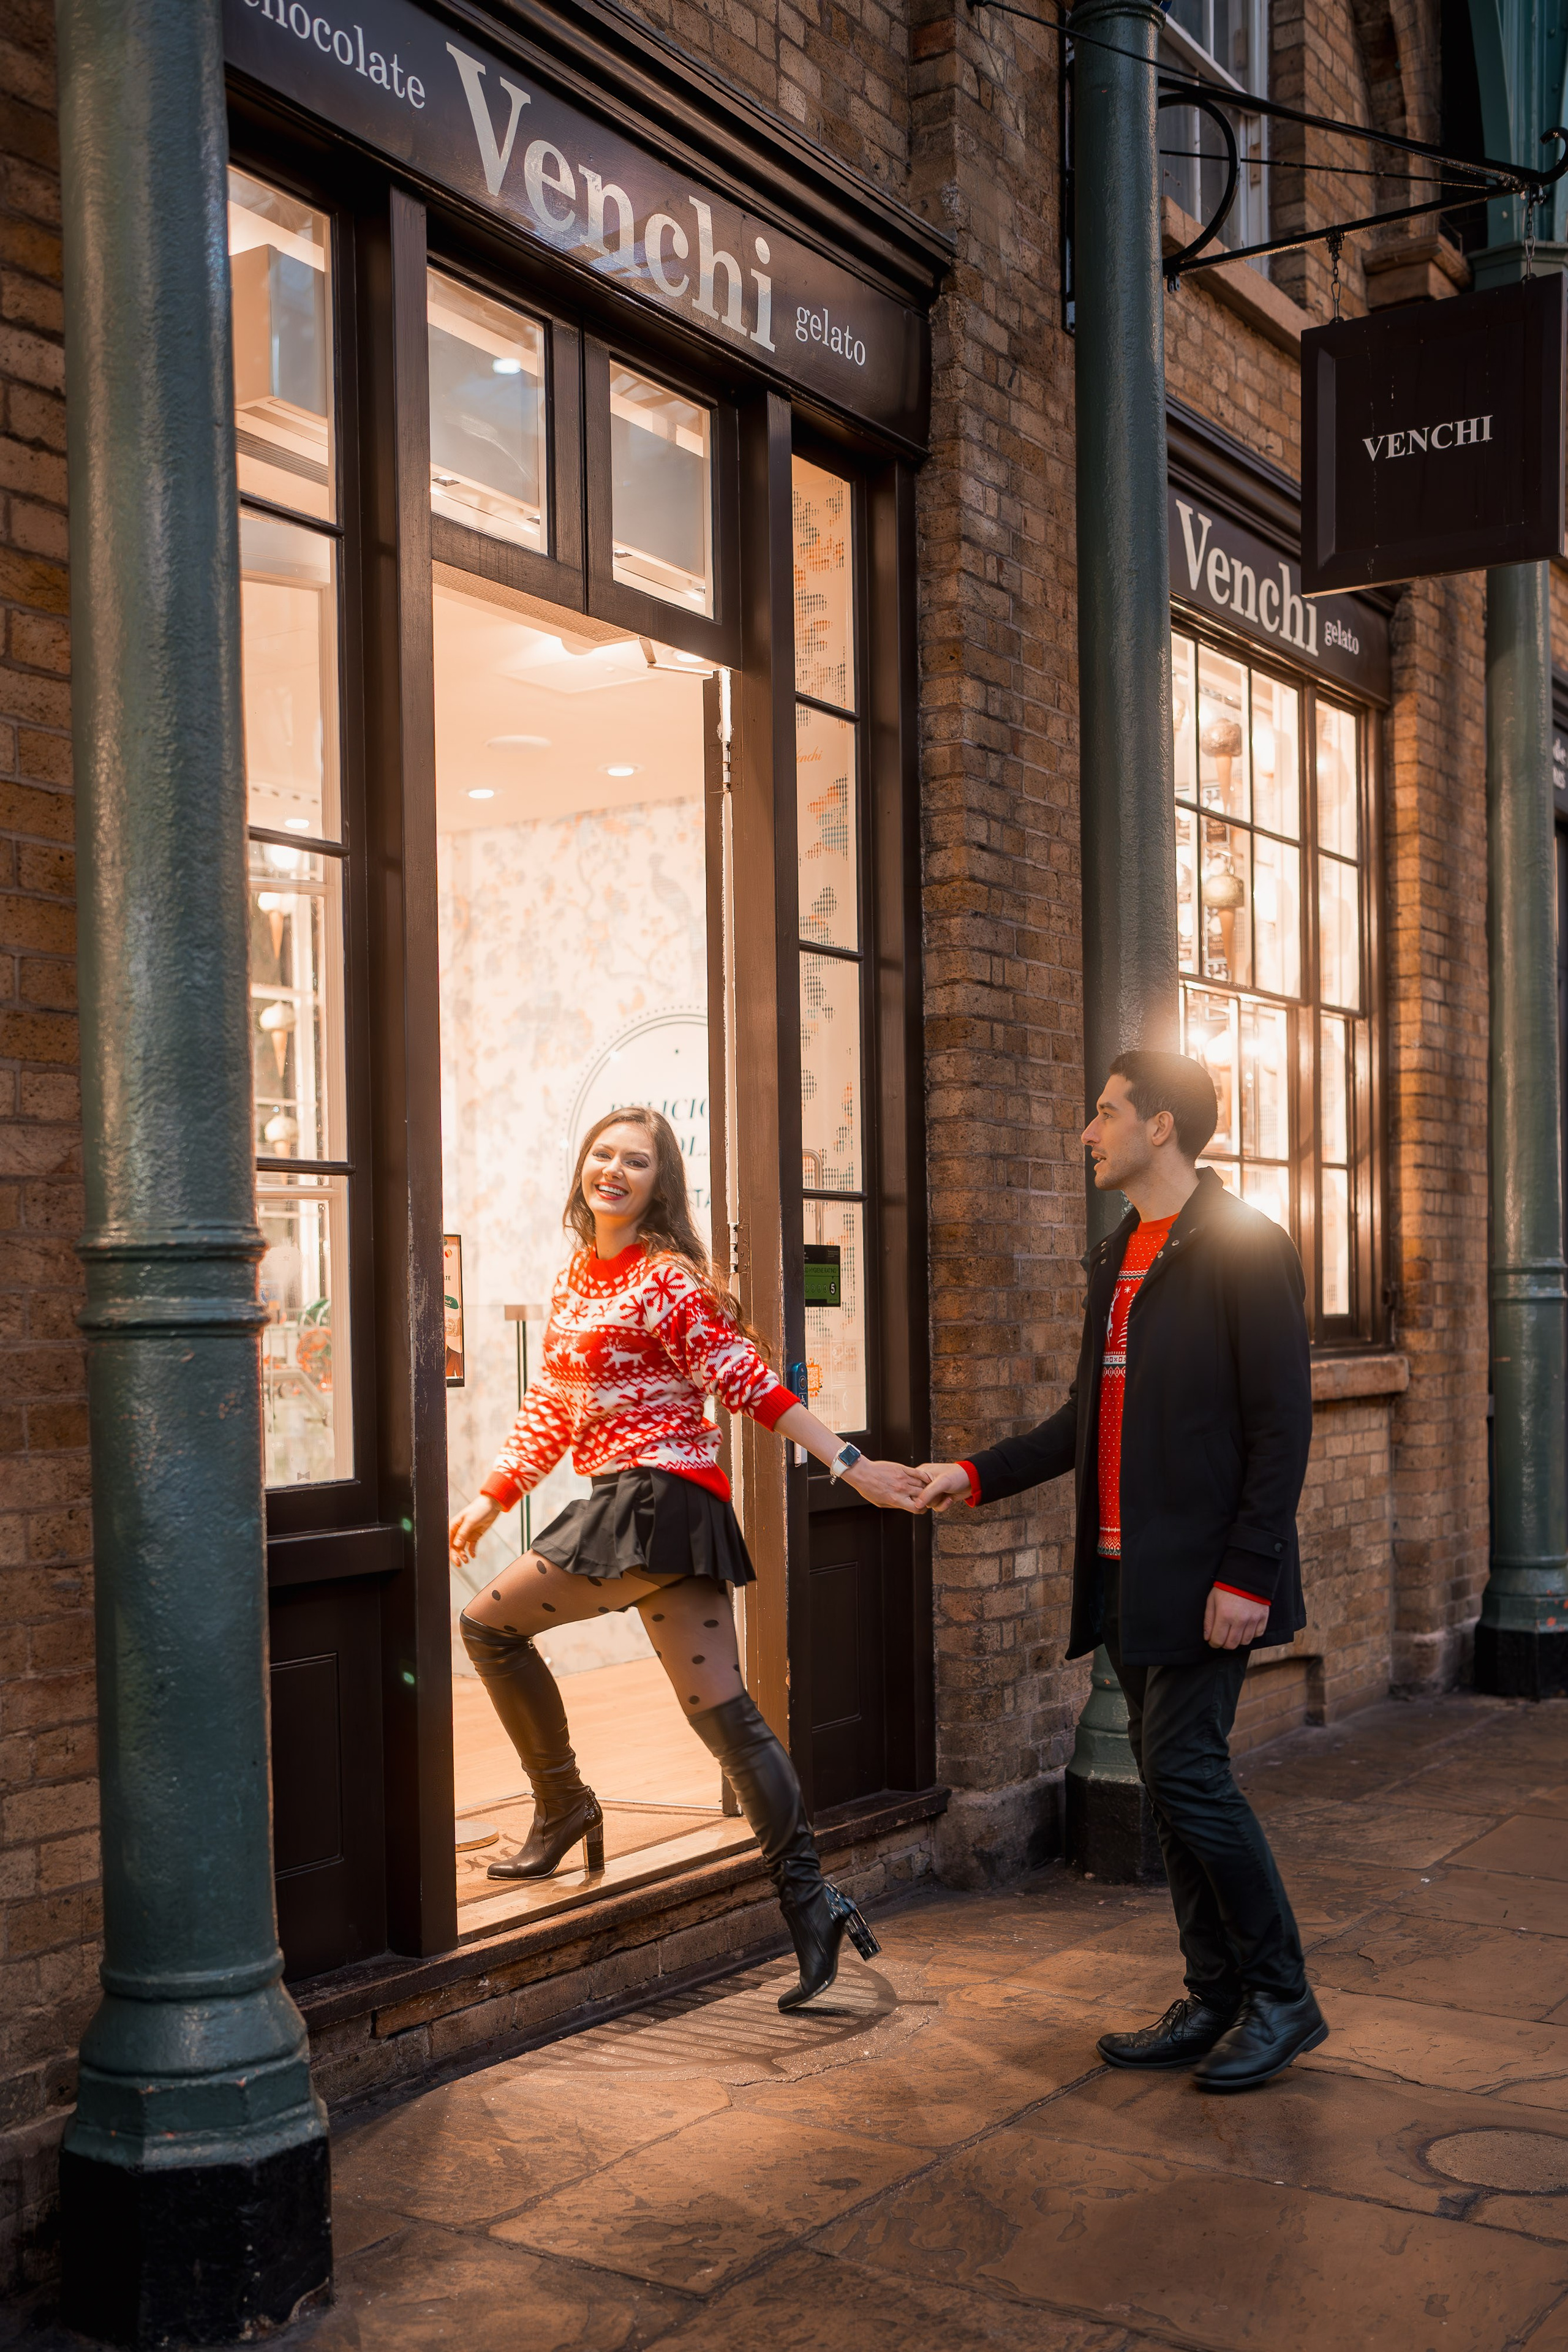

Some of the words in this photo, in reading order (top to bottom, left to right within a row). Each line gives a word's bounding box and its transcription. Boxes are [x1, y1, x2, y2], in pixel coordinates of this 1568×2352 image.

[244, 0, 426, 109] ocolate
[446, 41, 775, 352] Venchi
[796, 306, 866, 366] gelato
[1362, 415, 1493, 462] VENCHI
[1175, 499, 1319, 657] Venchi
[1324, 620, 1359, 655] gelato
[831, 1283, 835, 1294] 5
